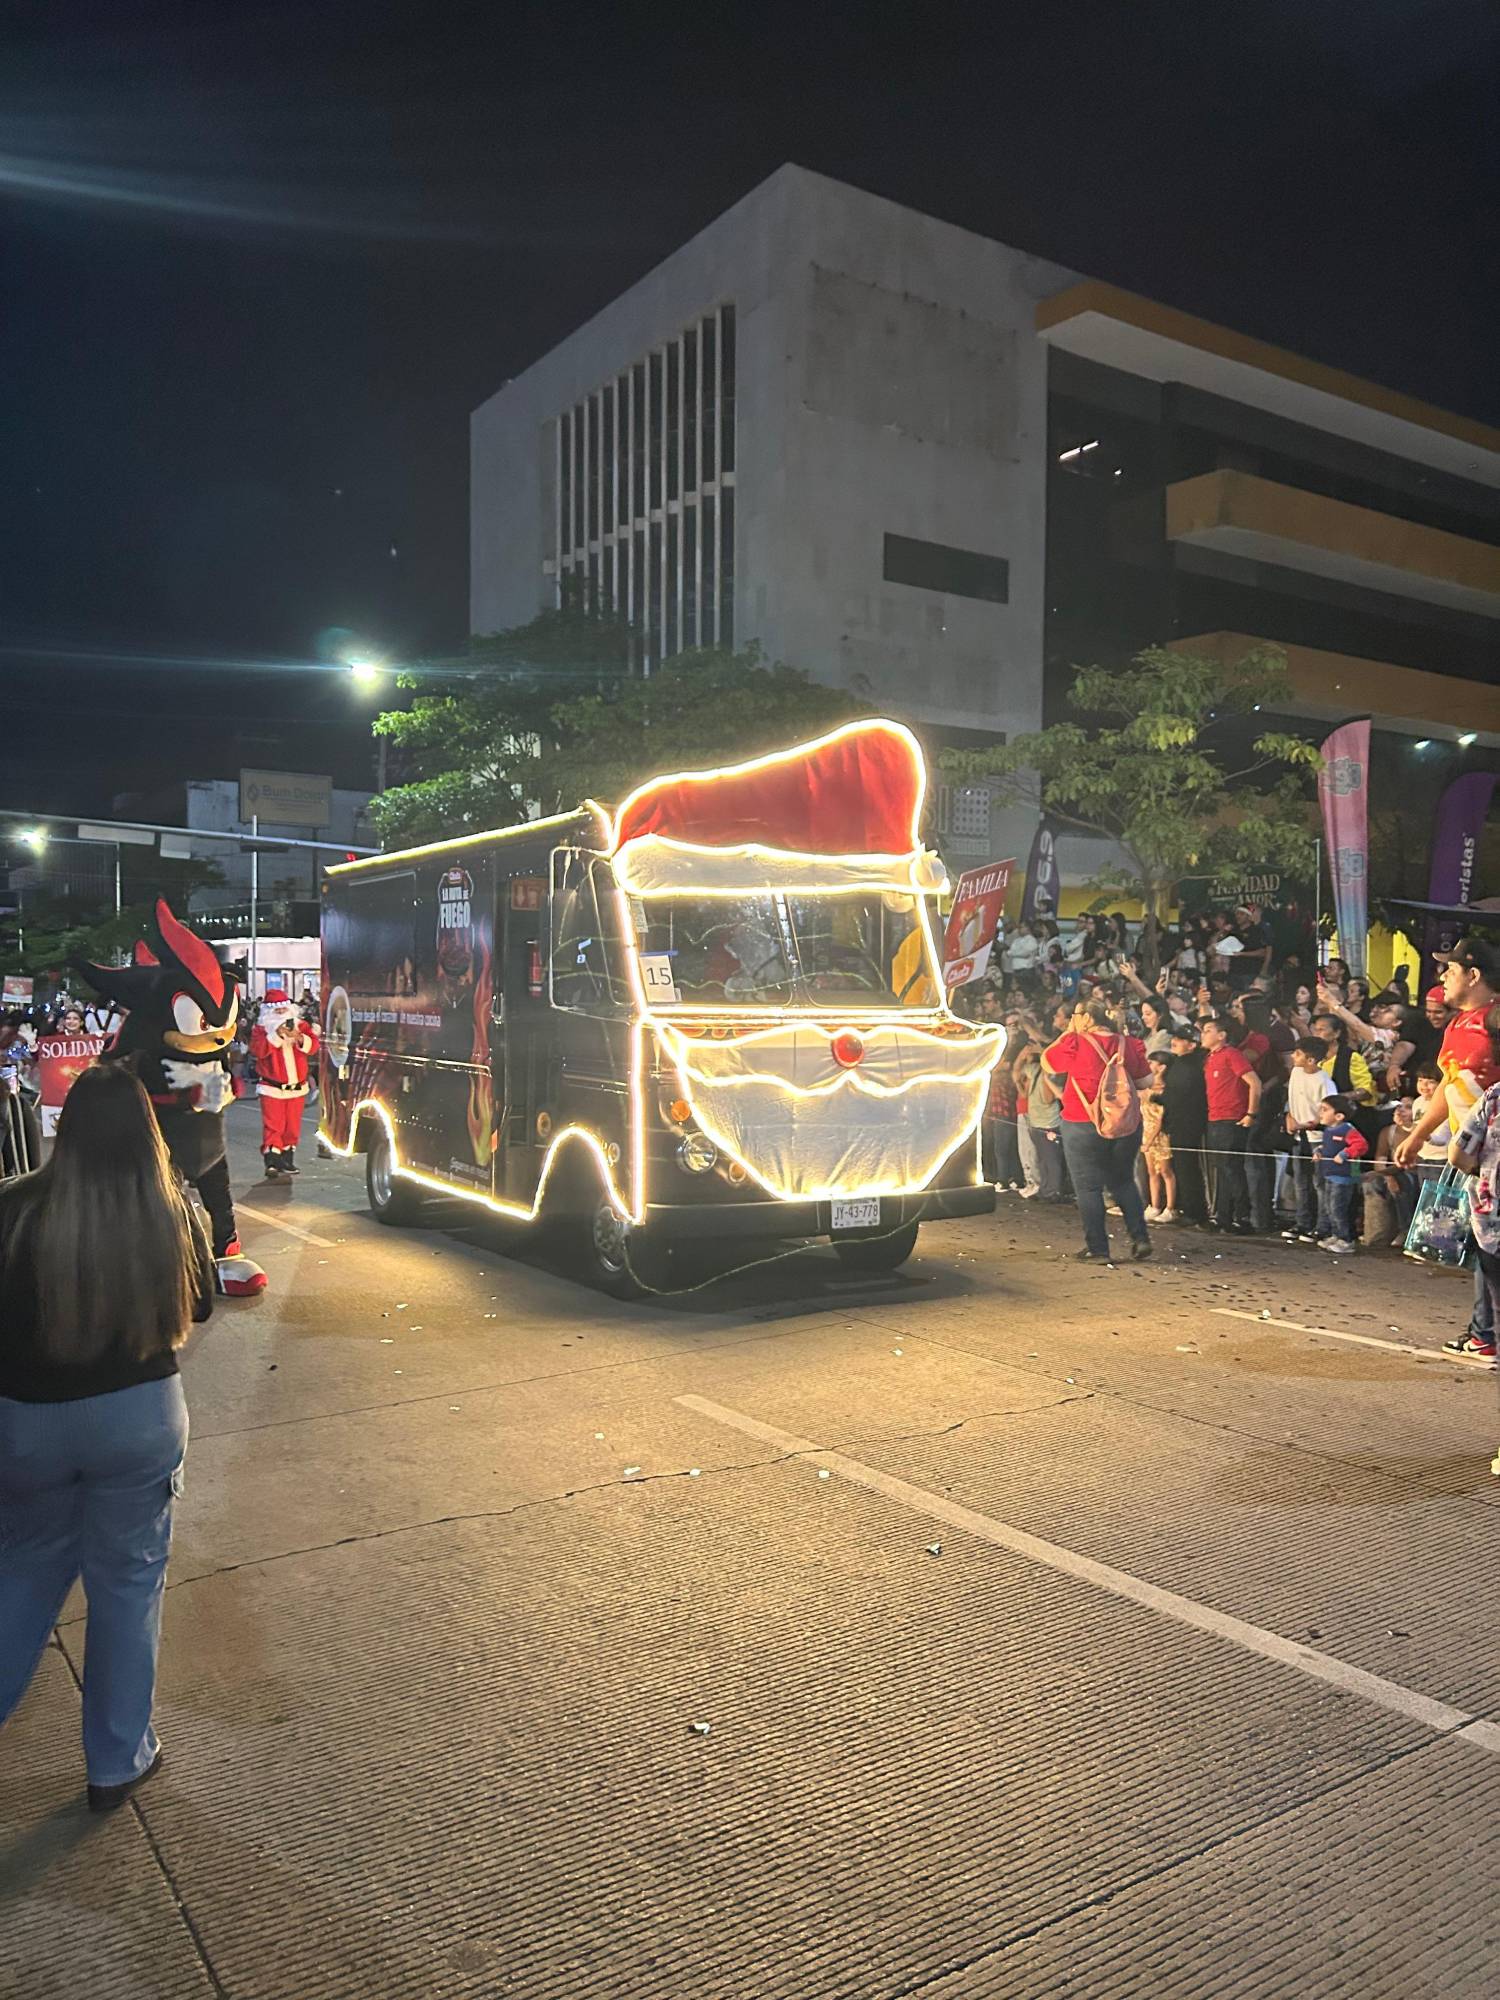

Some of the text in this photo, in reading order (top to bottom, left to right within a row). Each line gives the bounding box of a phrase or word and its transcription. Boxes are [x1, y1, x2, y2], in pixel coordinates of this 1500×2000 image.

[958, 869, 1009, 903] FAMILIA
[440, 901, 471, 929] FUEGO
[646, 967, 672, 986] 15
[41, 1040, 104, 1059] SOLIDAR
[834, 1204, 878, 1220] JY-43-778
